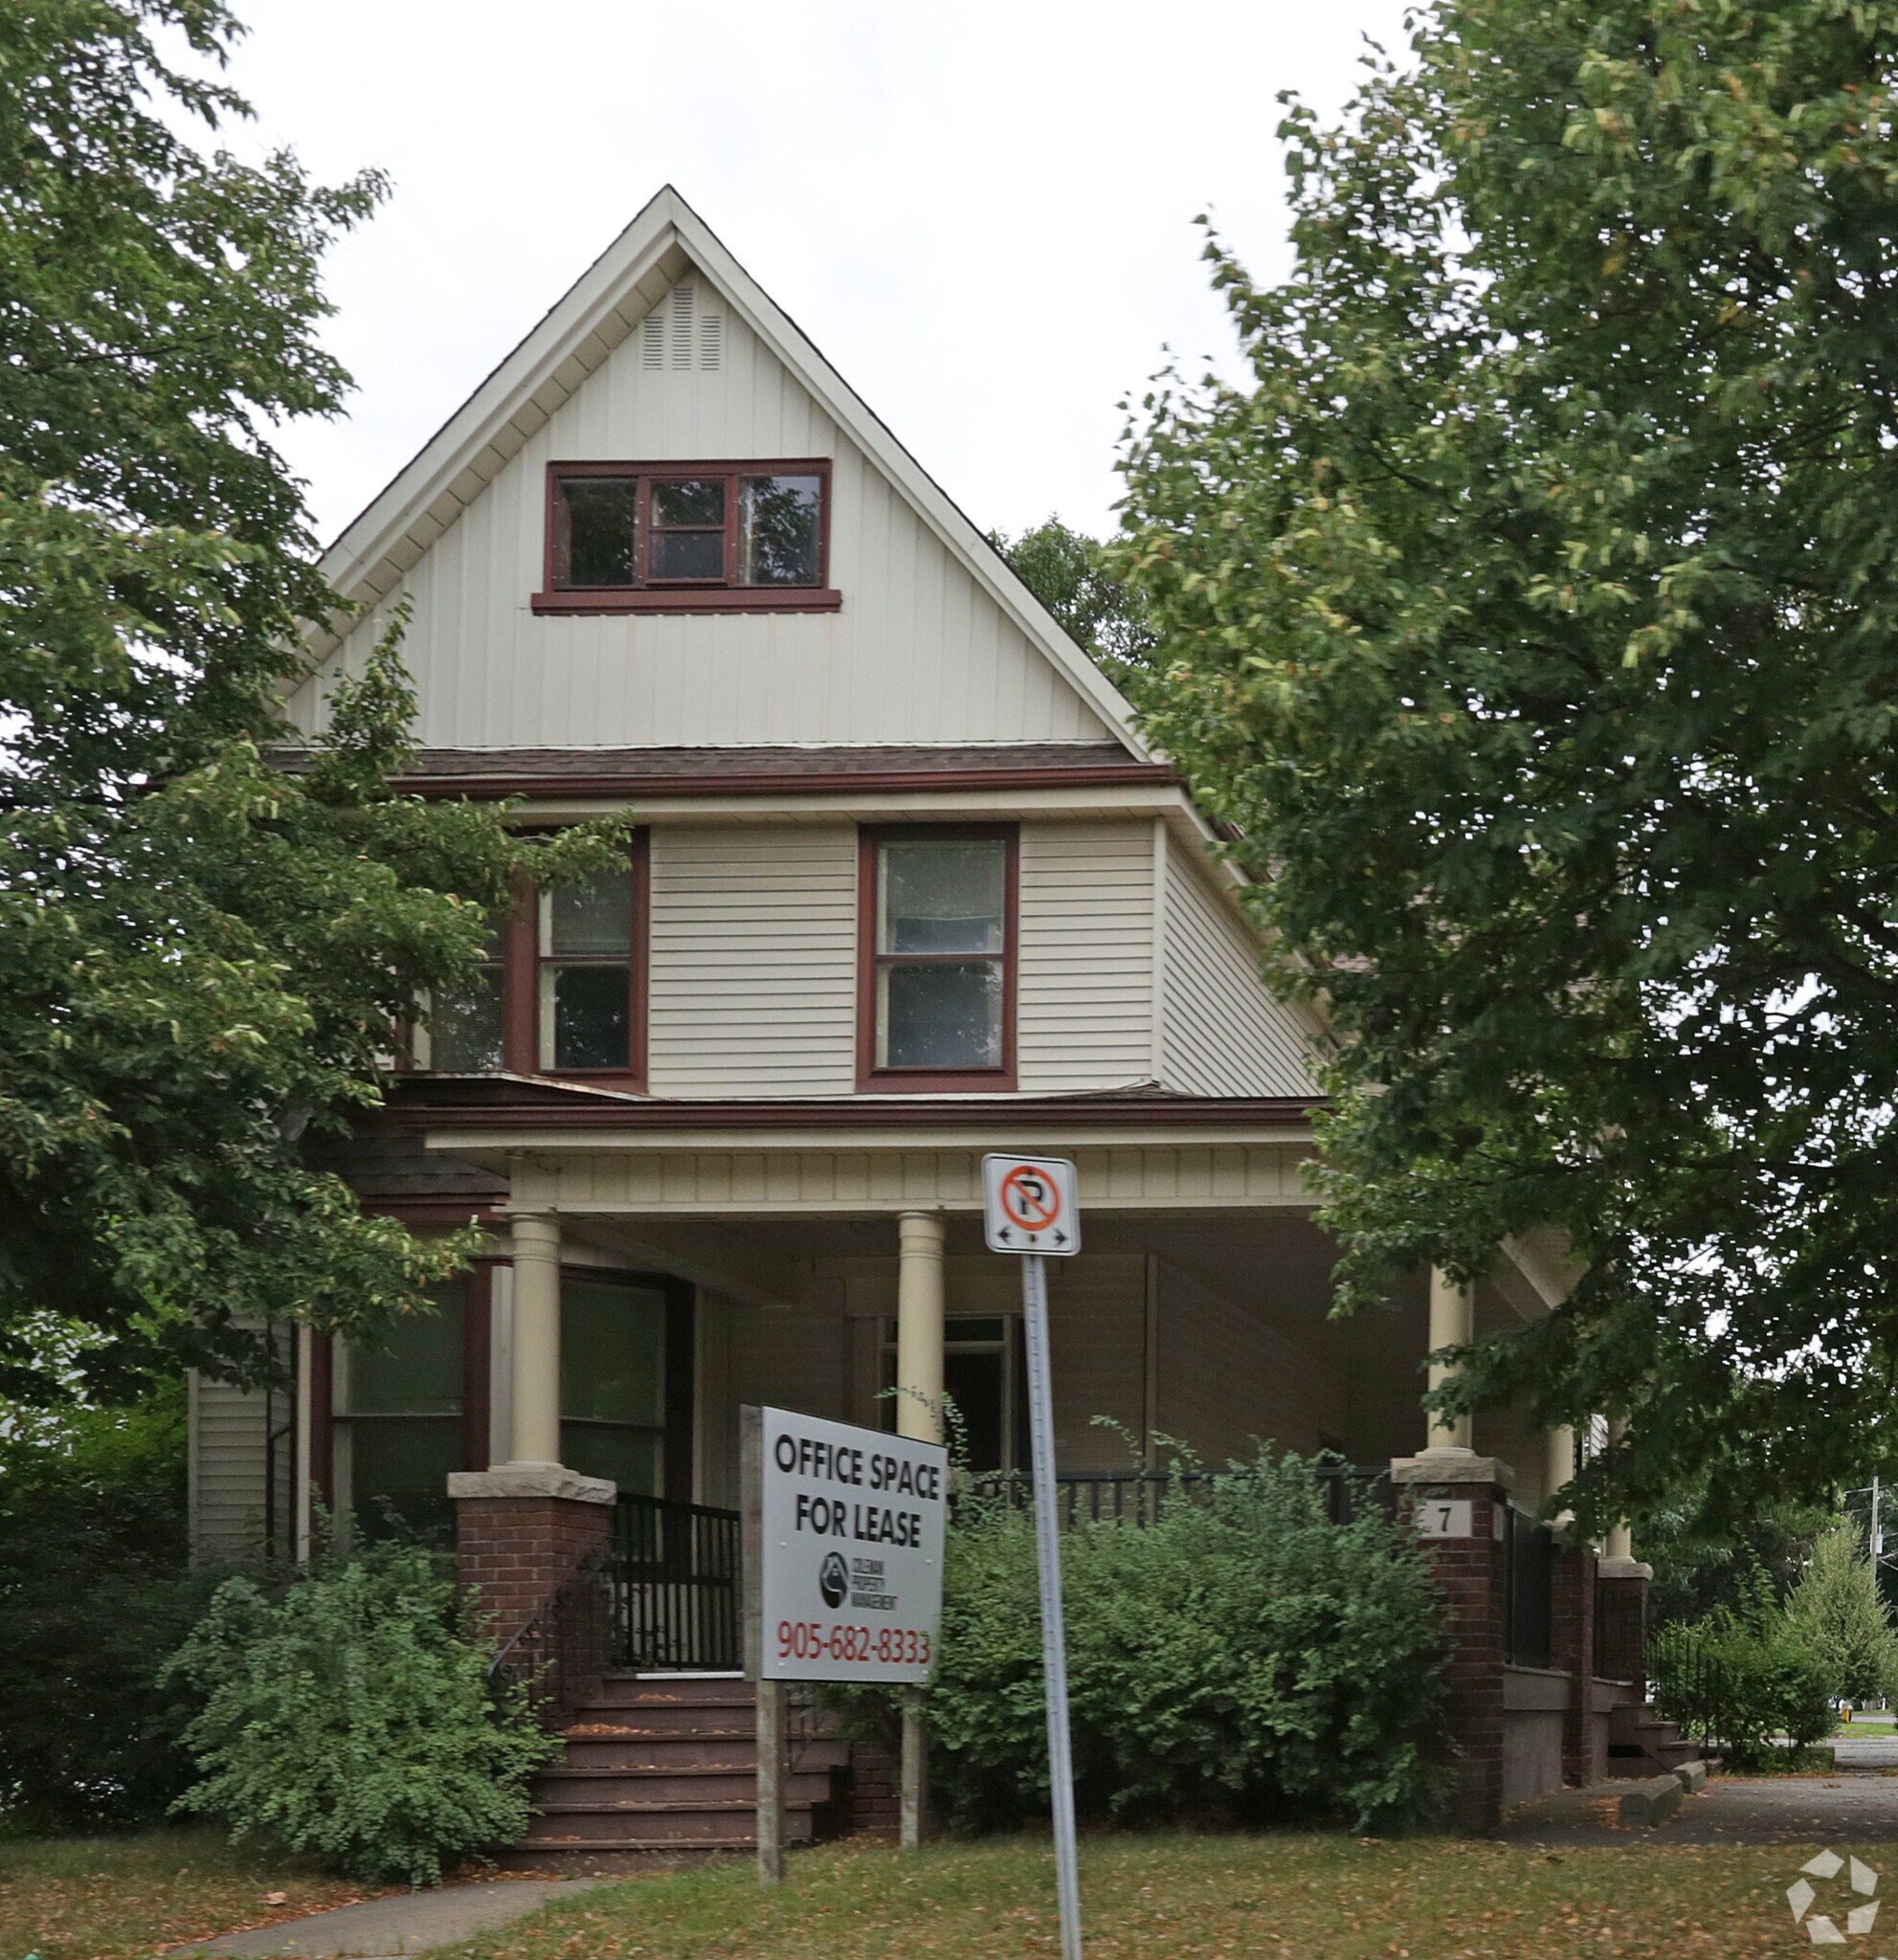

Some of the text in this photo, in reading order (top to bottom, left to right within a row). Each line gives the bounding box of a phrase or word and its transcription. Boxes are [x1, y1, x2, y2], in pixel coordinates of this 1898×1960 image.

[1016, 1179, 1043, 1215] P
[774, 1434, 940, 1501] OFFICE SPACE
[795, 1494, 922, 1548] FOR LEASE
[1439, 1507, 1451, 1532] 7
[777, 1620, 930, 1664] 905-682-8333
